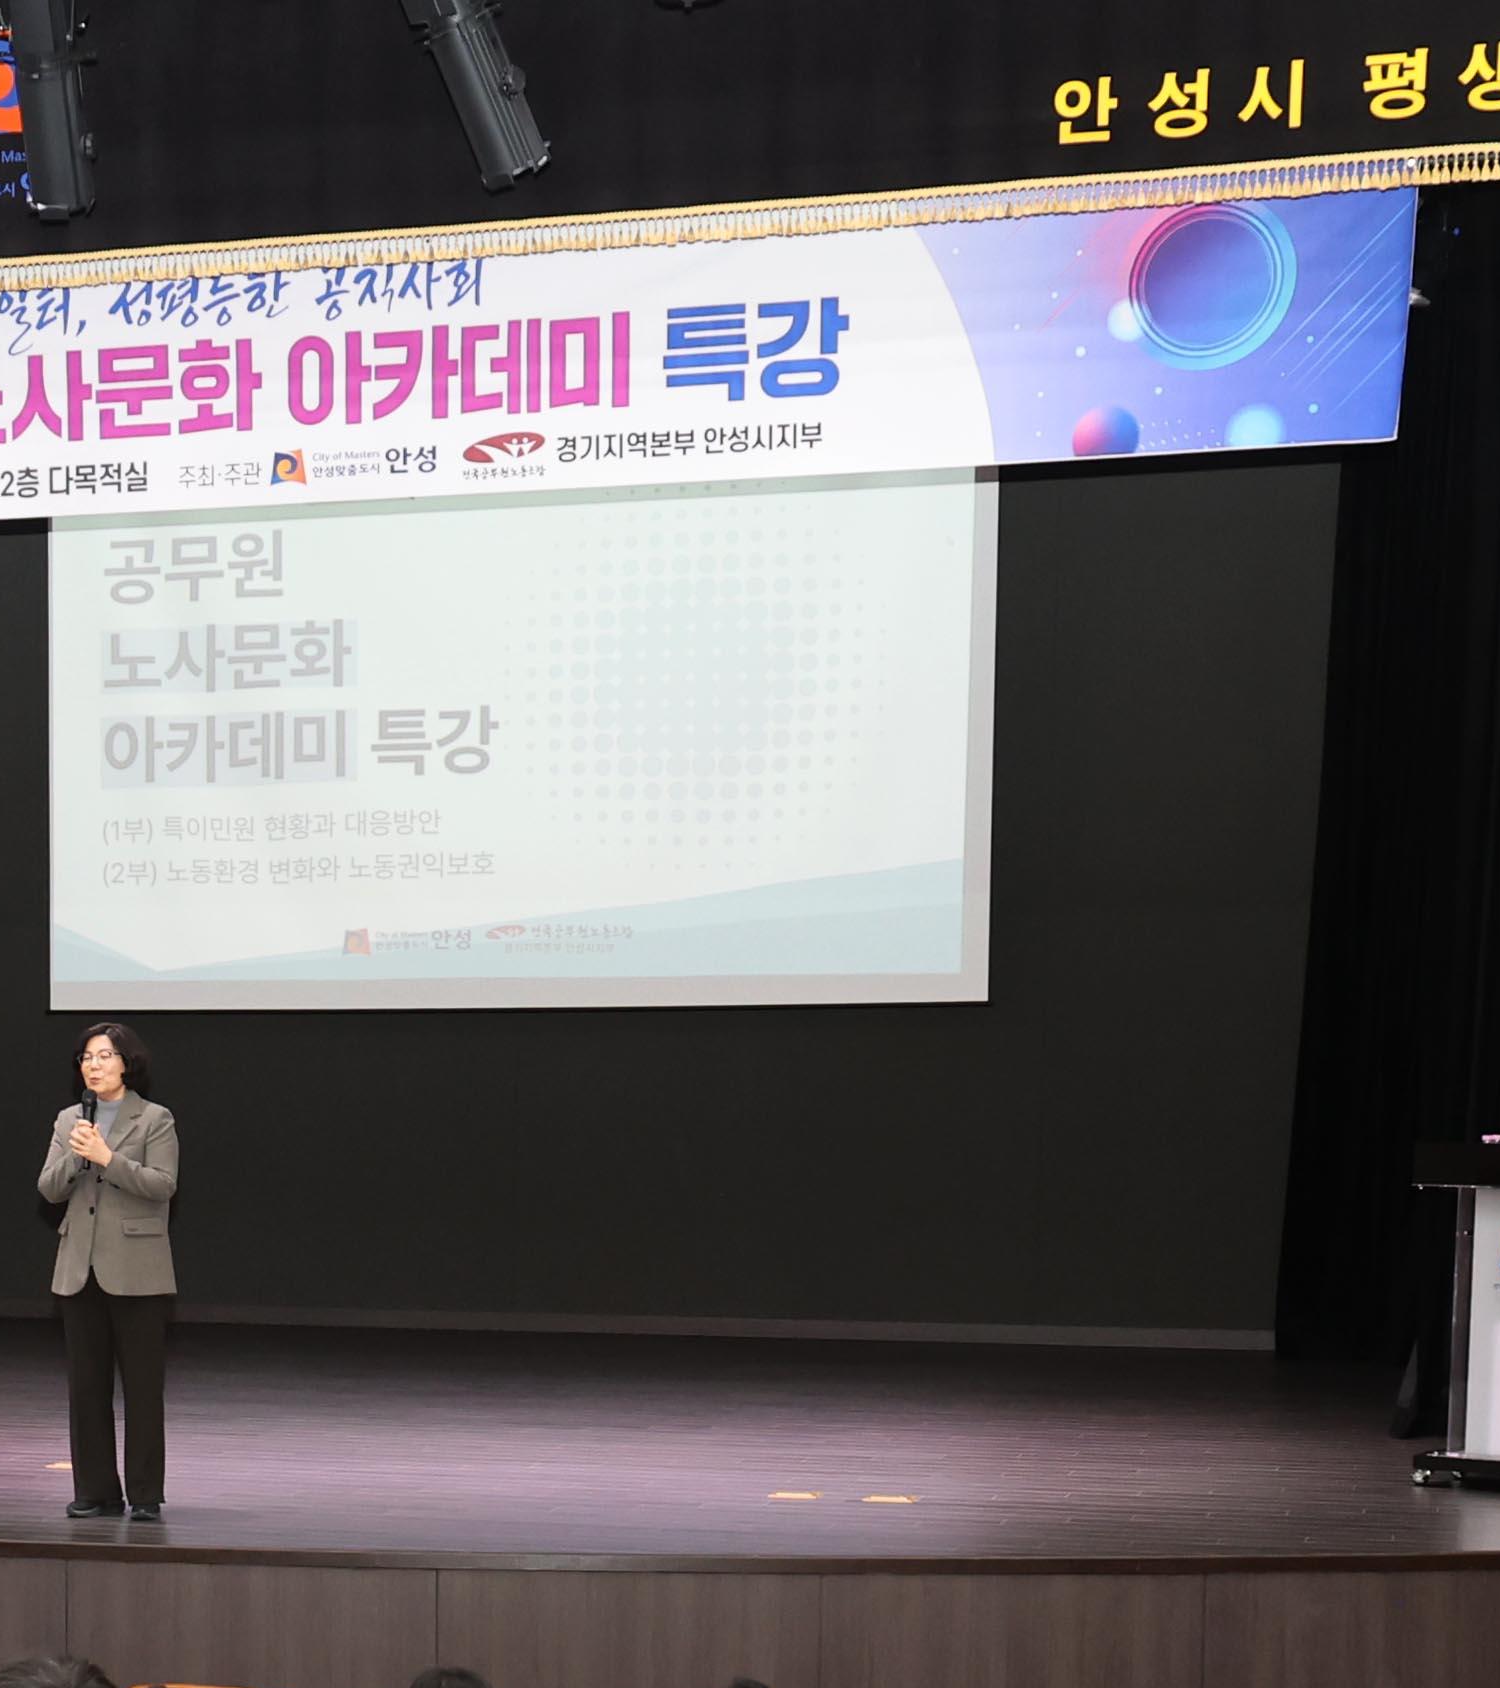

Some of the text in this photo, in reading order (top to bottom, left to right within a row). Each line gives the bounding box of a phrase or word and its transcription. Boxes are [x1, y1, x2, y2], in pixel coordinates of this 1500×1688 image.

[1053, 59, 1305, 145] 안성시
[287, 311, 630, 425] 아카데미
[662, 296, 850, 401] 특강
[312, 450, 381, 463] City of Masters
[385, 445, 438, 475] 안성
[556, 421, 823, 463] 경기지역본부 안성시지부
[0, 467, 40, 499] 2층
[49, 461, 149, 496] 다목적실
[312, 463, 381, 478] 안성맞춤도시
[103, 529, 284, 605] 공무원
[103, 618, 352, 693] 노사문화
[103, 704, 500, 783] 아카데미 특강
[102, 808, 442, 846] (1부) 특이민원 현황과 대응방안
[103, 851, 497, 888] (2부) 노동환경 변화와 노동권익보호
[431, 929, 473, 951] 안성
